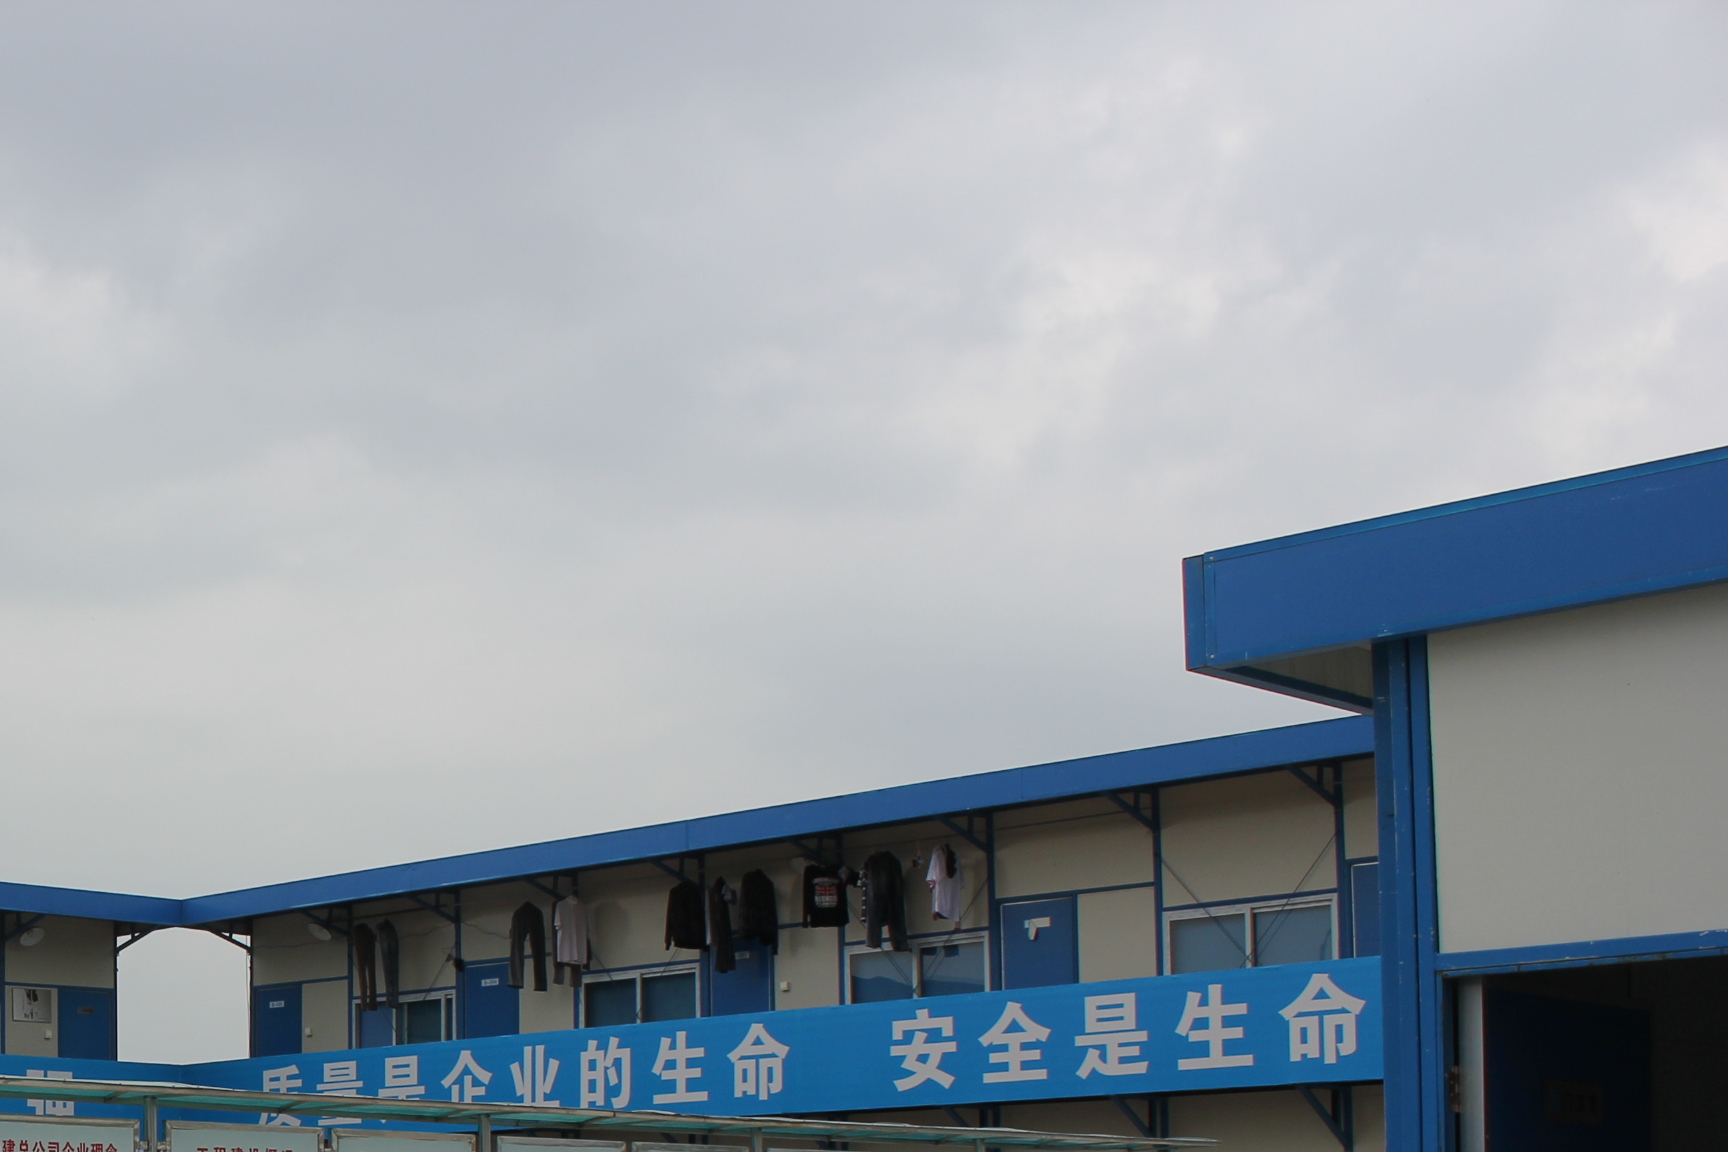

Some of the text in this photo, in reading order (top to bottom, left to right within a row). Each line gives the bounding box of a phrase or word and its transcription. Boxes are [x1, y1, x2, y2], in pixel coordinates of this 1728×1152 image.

[890, 972, 1366, 1093] 安全是生命
